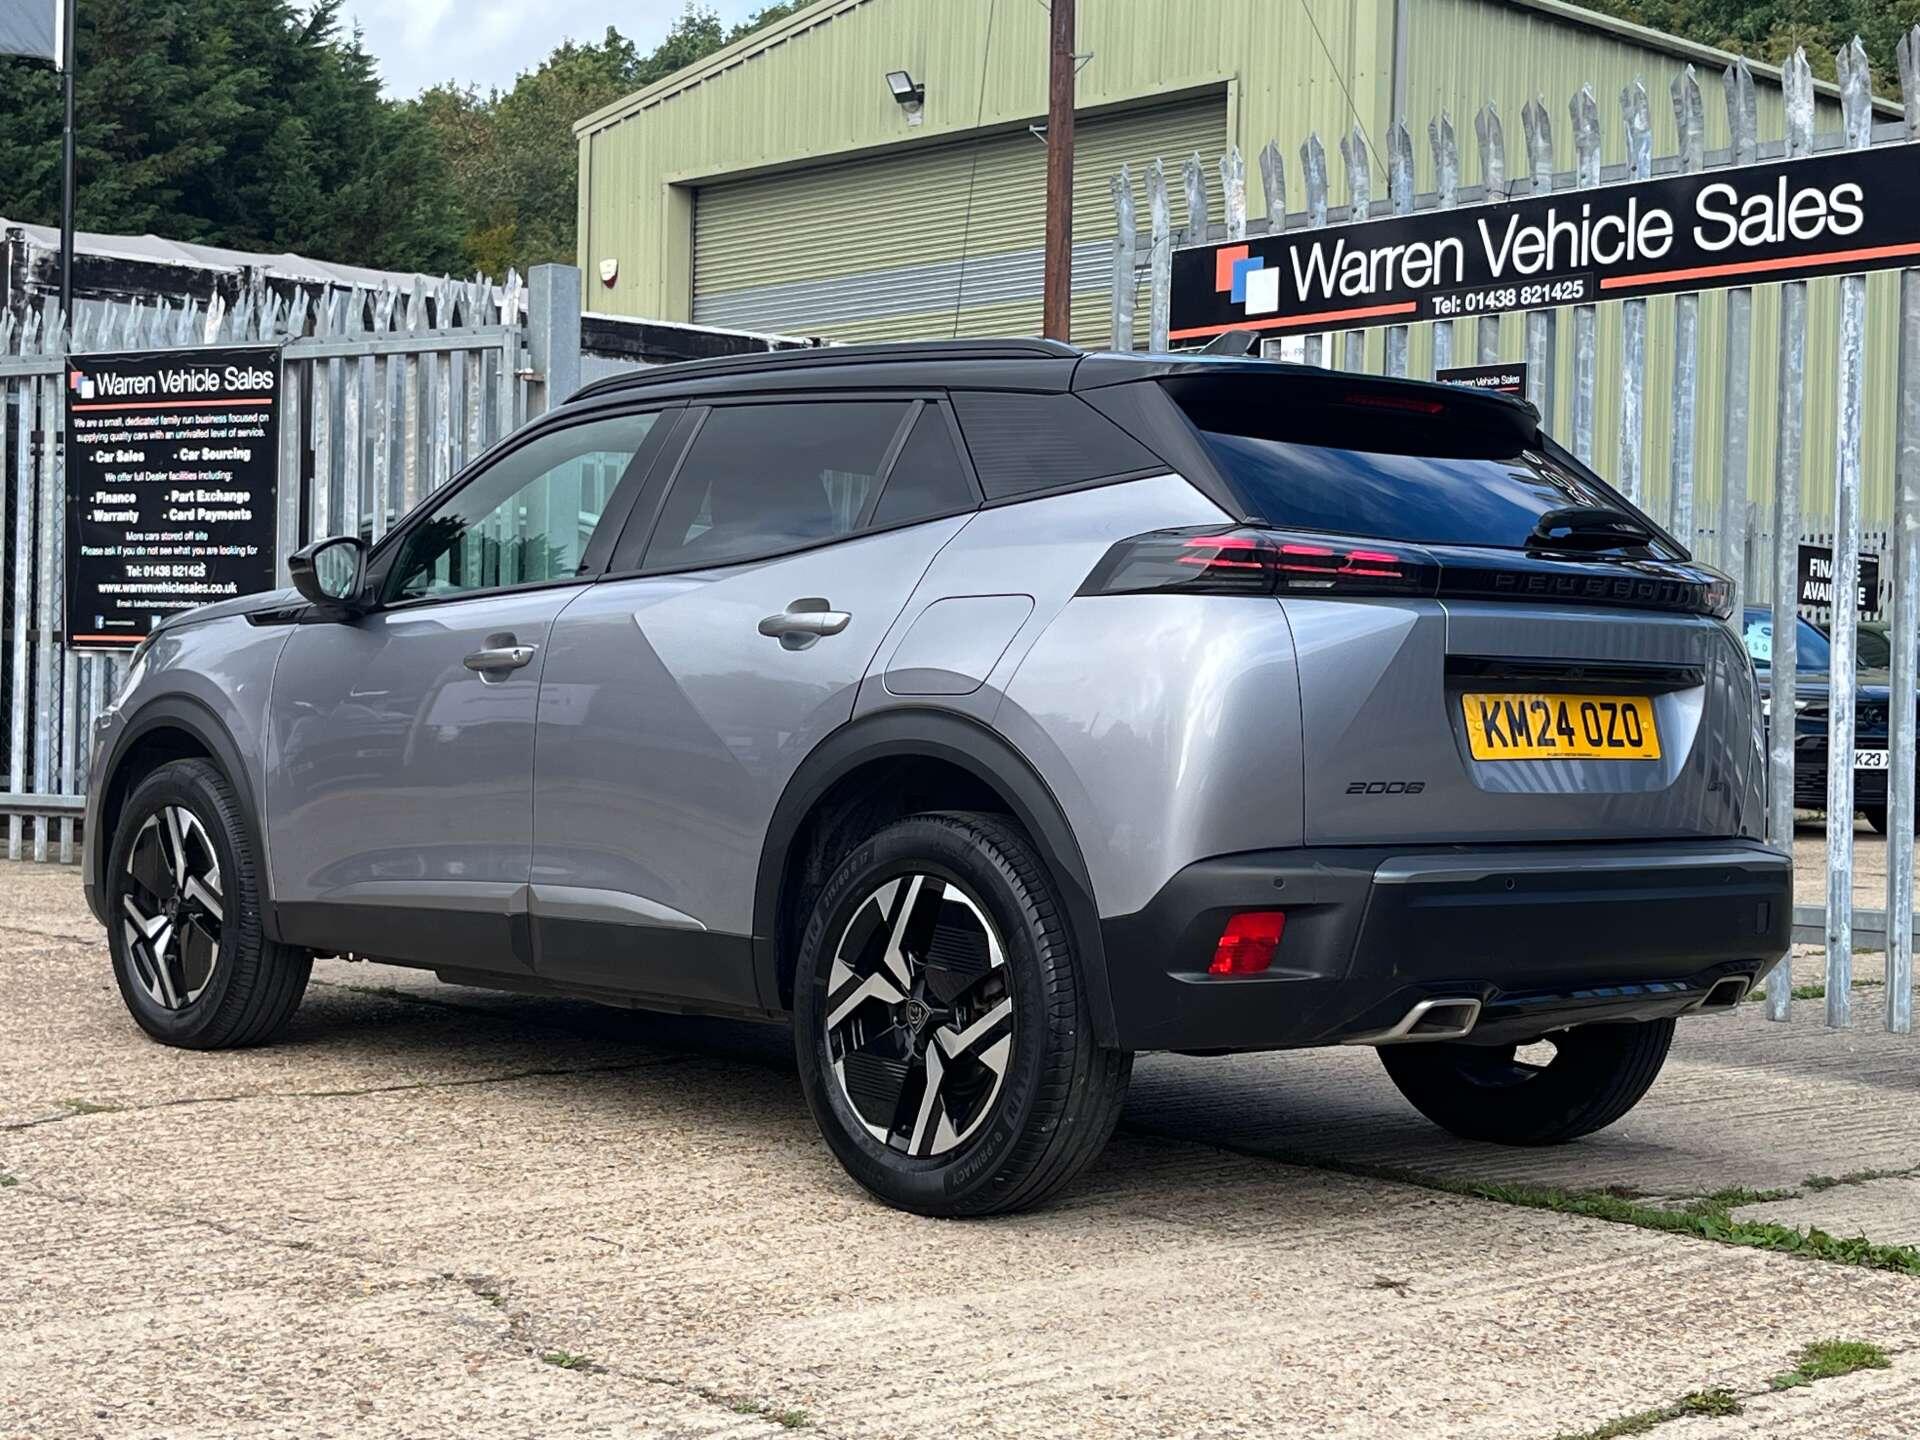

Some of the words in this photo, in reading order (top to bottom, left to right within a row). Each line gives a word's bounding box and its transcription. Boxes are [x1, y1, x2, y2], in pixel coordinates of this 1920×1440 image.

[1290, 237, 1463, 301] Warren
[1477, 197, 1674, 278] Vehicle
[1693, 175, 1864, 251] Sales
[1432, 295, 1461, 315] Tel:
[1465, 288, 1516, 311] 01438
[1520, 280, 1584, 305] 821425
[96, 372, 155, 395] Warren
[159, 368, 220, 393] Vehicle
[224, 366, 274, 391] Sales
[1501, 374, 1520, 384] Sales
[74, 418, 85, 428] We
[86, 419, 97, 427] are
[125, 416, 159, 426] dedicated
[160, 415, 181, 427] family
[182, 416, 194, 424] run
[195, 414, 227, 424] business
[228, 413, 258, 423] focused
[259, 414, 269, 422] on
[77, 432, 108, 443] supplying
[109, 431, 132, 443] quality
[133, 432, 148, 440] cars
[149, 430, 164, 439] with
[165, 431, 174, 439] an
[175, 429, 209, 439] unrivalled
[210, 428, 227, 438] level
[228, 428, 237, 437] of
[96, 450, 115, 463] Car
[116, 449, 145, 463] Sales
[180, 448, 200, 461] Car
[201, 446, 251, 462] Sourcing
[105, 472, 116, 482] We
[117, 471, 133, 481] offer
[133, 471, 144, 481] full
[145, 471, 168, 481] Dealer
[169, 470, 197, 480] facilities
[198, 470, 233, 482] including:
[95, 491, 137, 504] Finance
[171, 489, 195, 502] Part
[196, 489, 251, 504] Exchange
[93, 509, 139, 524] Warranty
[168, 508, 195, 521] Card
[197, 507, 252, 523] Payments
[126, 531, 144, 541] More
[144, 533, 160, 541] cars
[160, 531, 183, 541] stored
[184, 530, 194, 541] off
[195, 531, 208, 541] site
[81, 545, 103, 555] Please
[104, 545, 116, 555] ask
[123, 547, 135, 558] you
[136, 545, 146, 555] do
[146, 545, 158, 555] not
[159, 547, 172, 555] see
[173, 545, 191, 555] what
[192, 547, 205, 557] you
[206, 547, 218, 555] are
[219, 545, 246, 557] looking
[247, 544, 258, 555] for
[126, 565, 142, 577] Tel:
[143, 565, 171, 577] 01438
[172, 565, 206, 577] 821425
[1810, 558, 1861, 582] FINE
[98, 581, 238, 593] www.warrenvehiclesales.co.uk
[1495, 574, 1676, 598] PEUGEOT
[1802, 580, 1866, 605] AVAILE
[1479, 700, 1575, 748] KM24
[1580, 701, 1643, 747] OZO
[1855, 753, 1881, 766] K23
[1344, 782, 1426, 794] 2008
